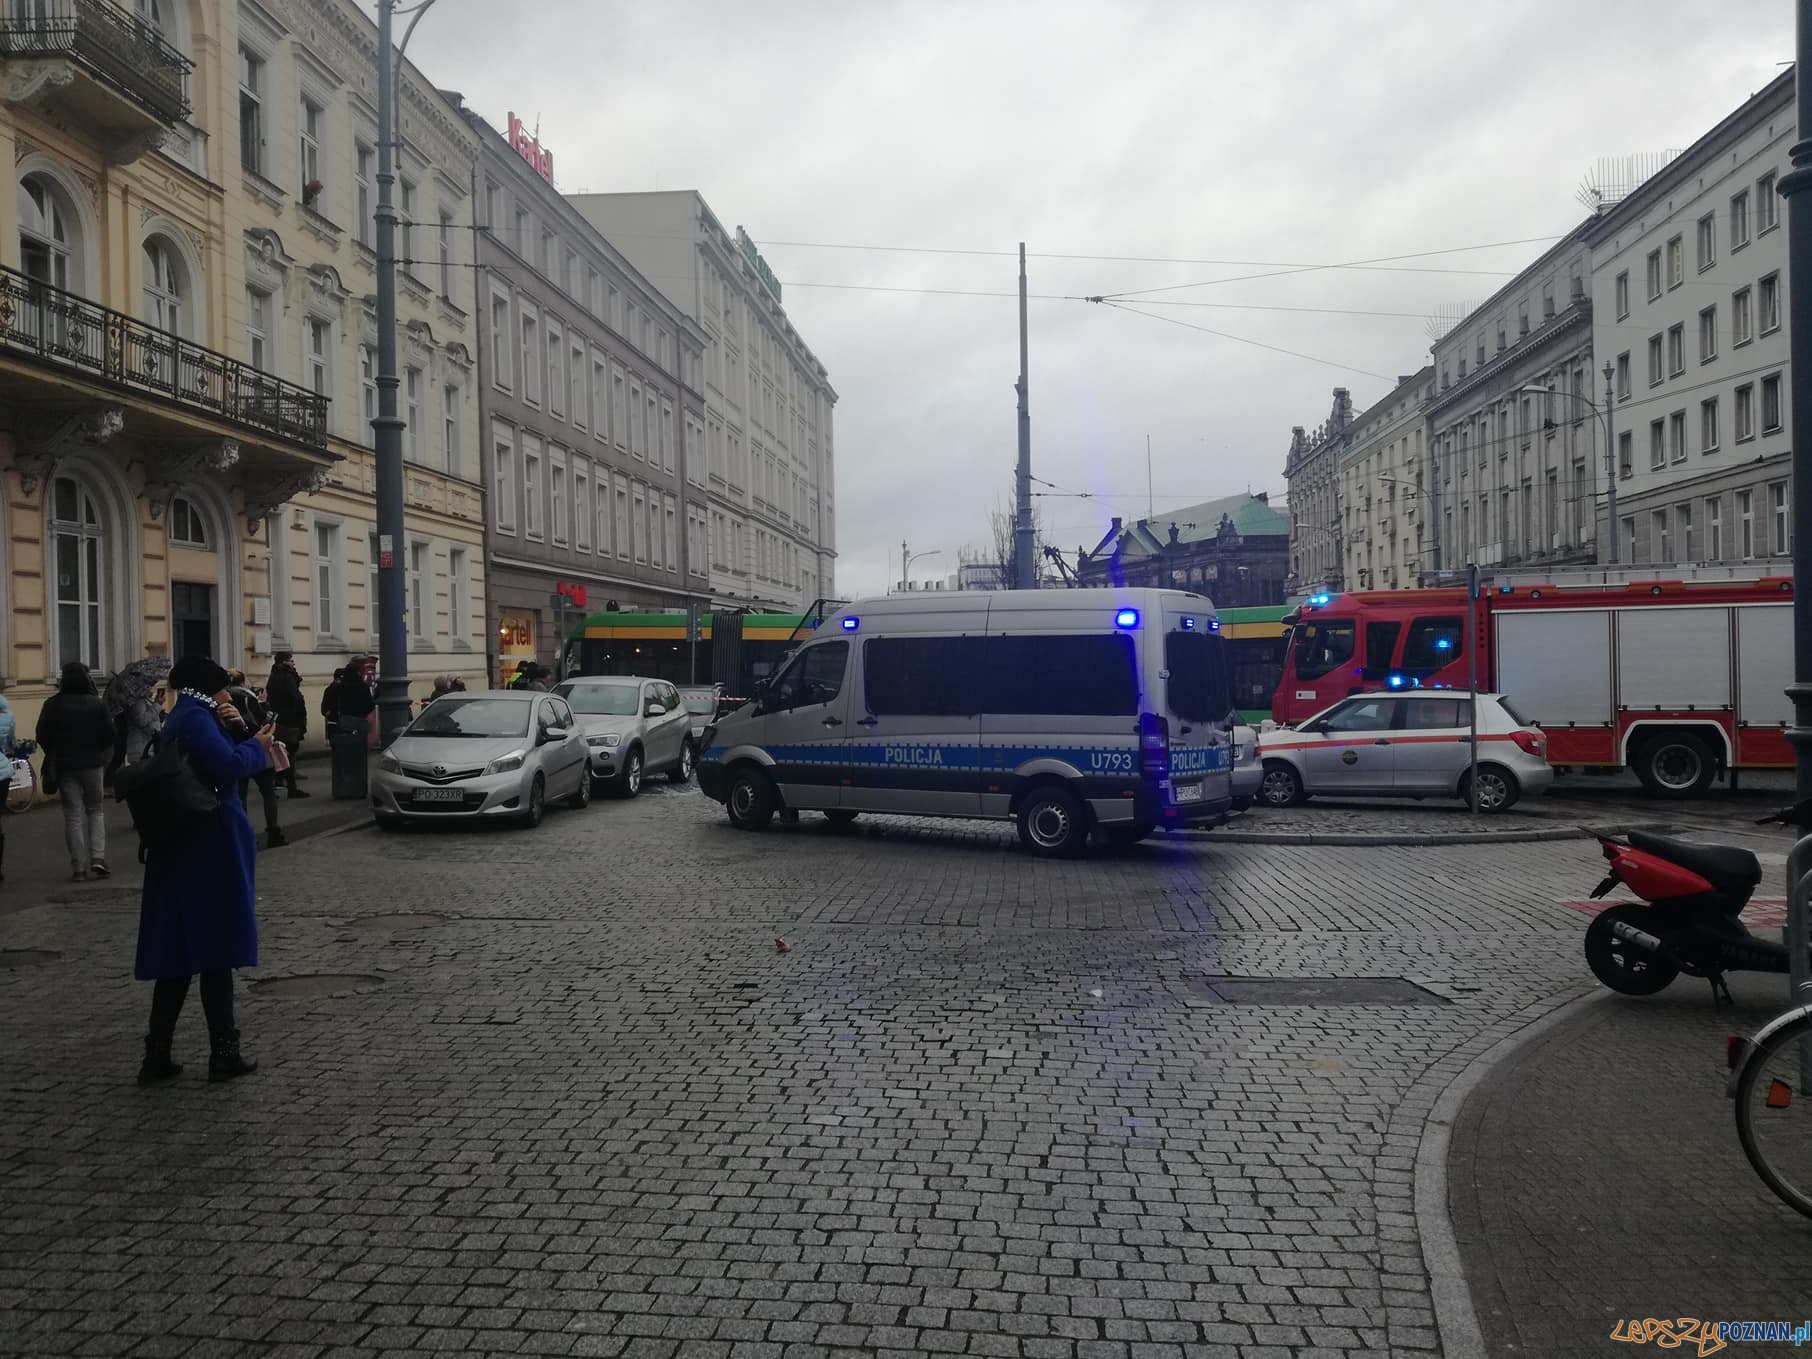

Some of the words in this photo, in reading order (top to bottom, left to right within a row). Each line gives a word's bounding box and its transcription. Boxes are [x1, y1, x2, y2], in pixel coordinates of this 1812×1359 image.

[885, 747, 943, 764] POLICJA
[1091, 753, 1132, 769] U793
[1171, 752, 1206, 770] POLICJA
